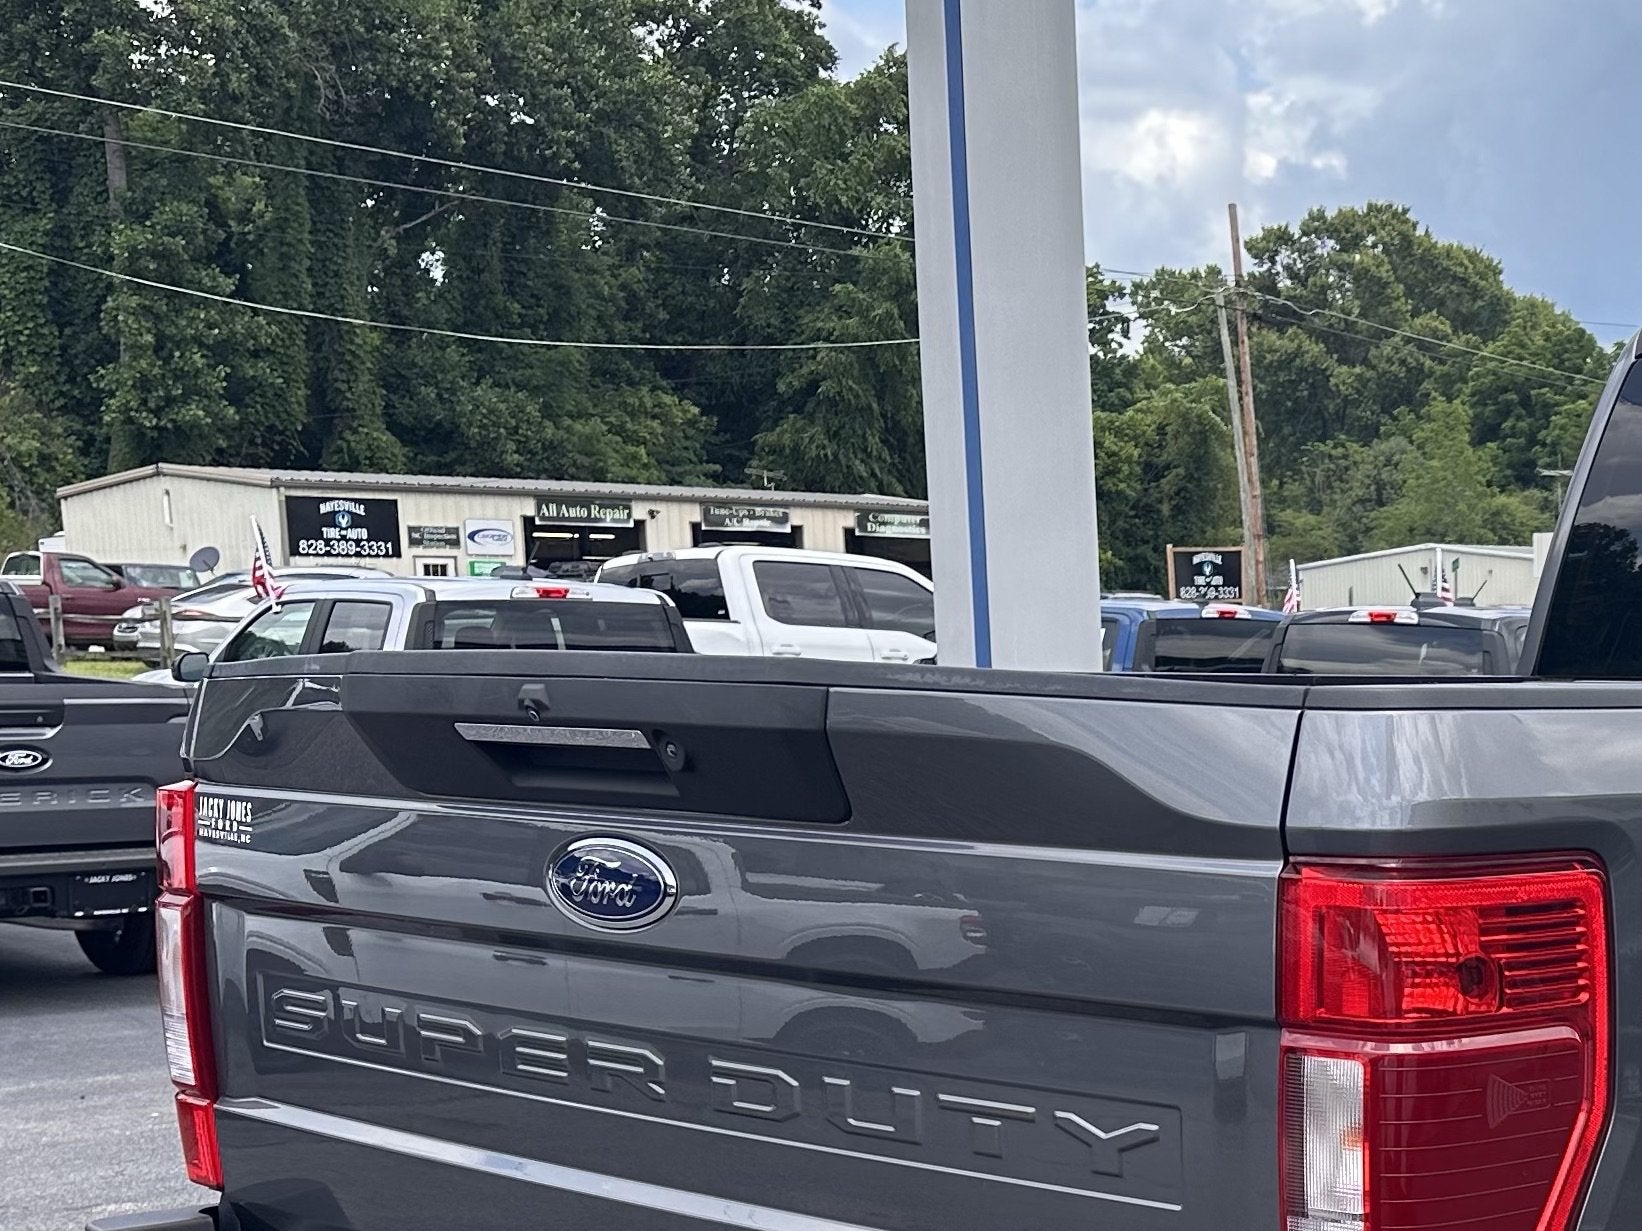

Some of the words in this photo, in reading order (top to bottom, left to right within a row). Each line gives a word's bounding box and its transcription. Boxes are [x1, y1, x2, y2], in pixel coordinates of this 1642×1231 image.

[540, 503, 557, 517] All
[559, 504, 588, 518] Auto
[590, 504, 630, 522] Repair
[298, 539, 393, 555] 828-389-3331
[199, 796, 224, 819] JACKY
[226, 800, 252, 823] JONES
[211, 817, 238, 832] FORD
[569, 855, 638, 908] Ford
[269, 987, 667, 1100] SUPER
[706, 1056, 1160, 1178] DUTY
